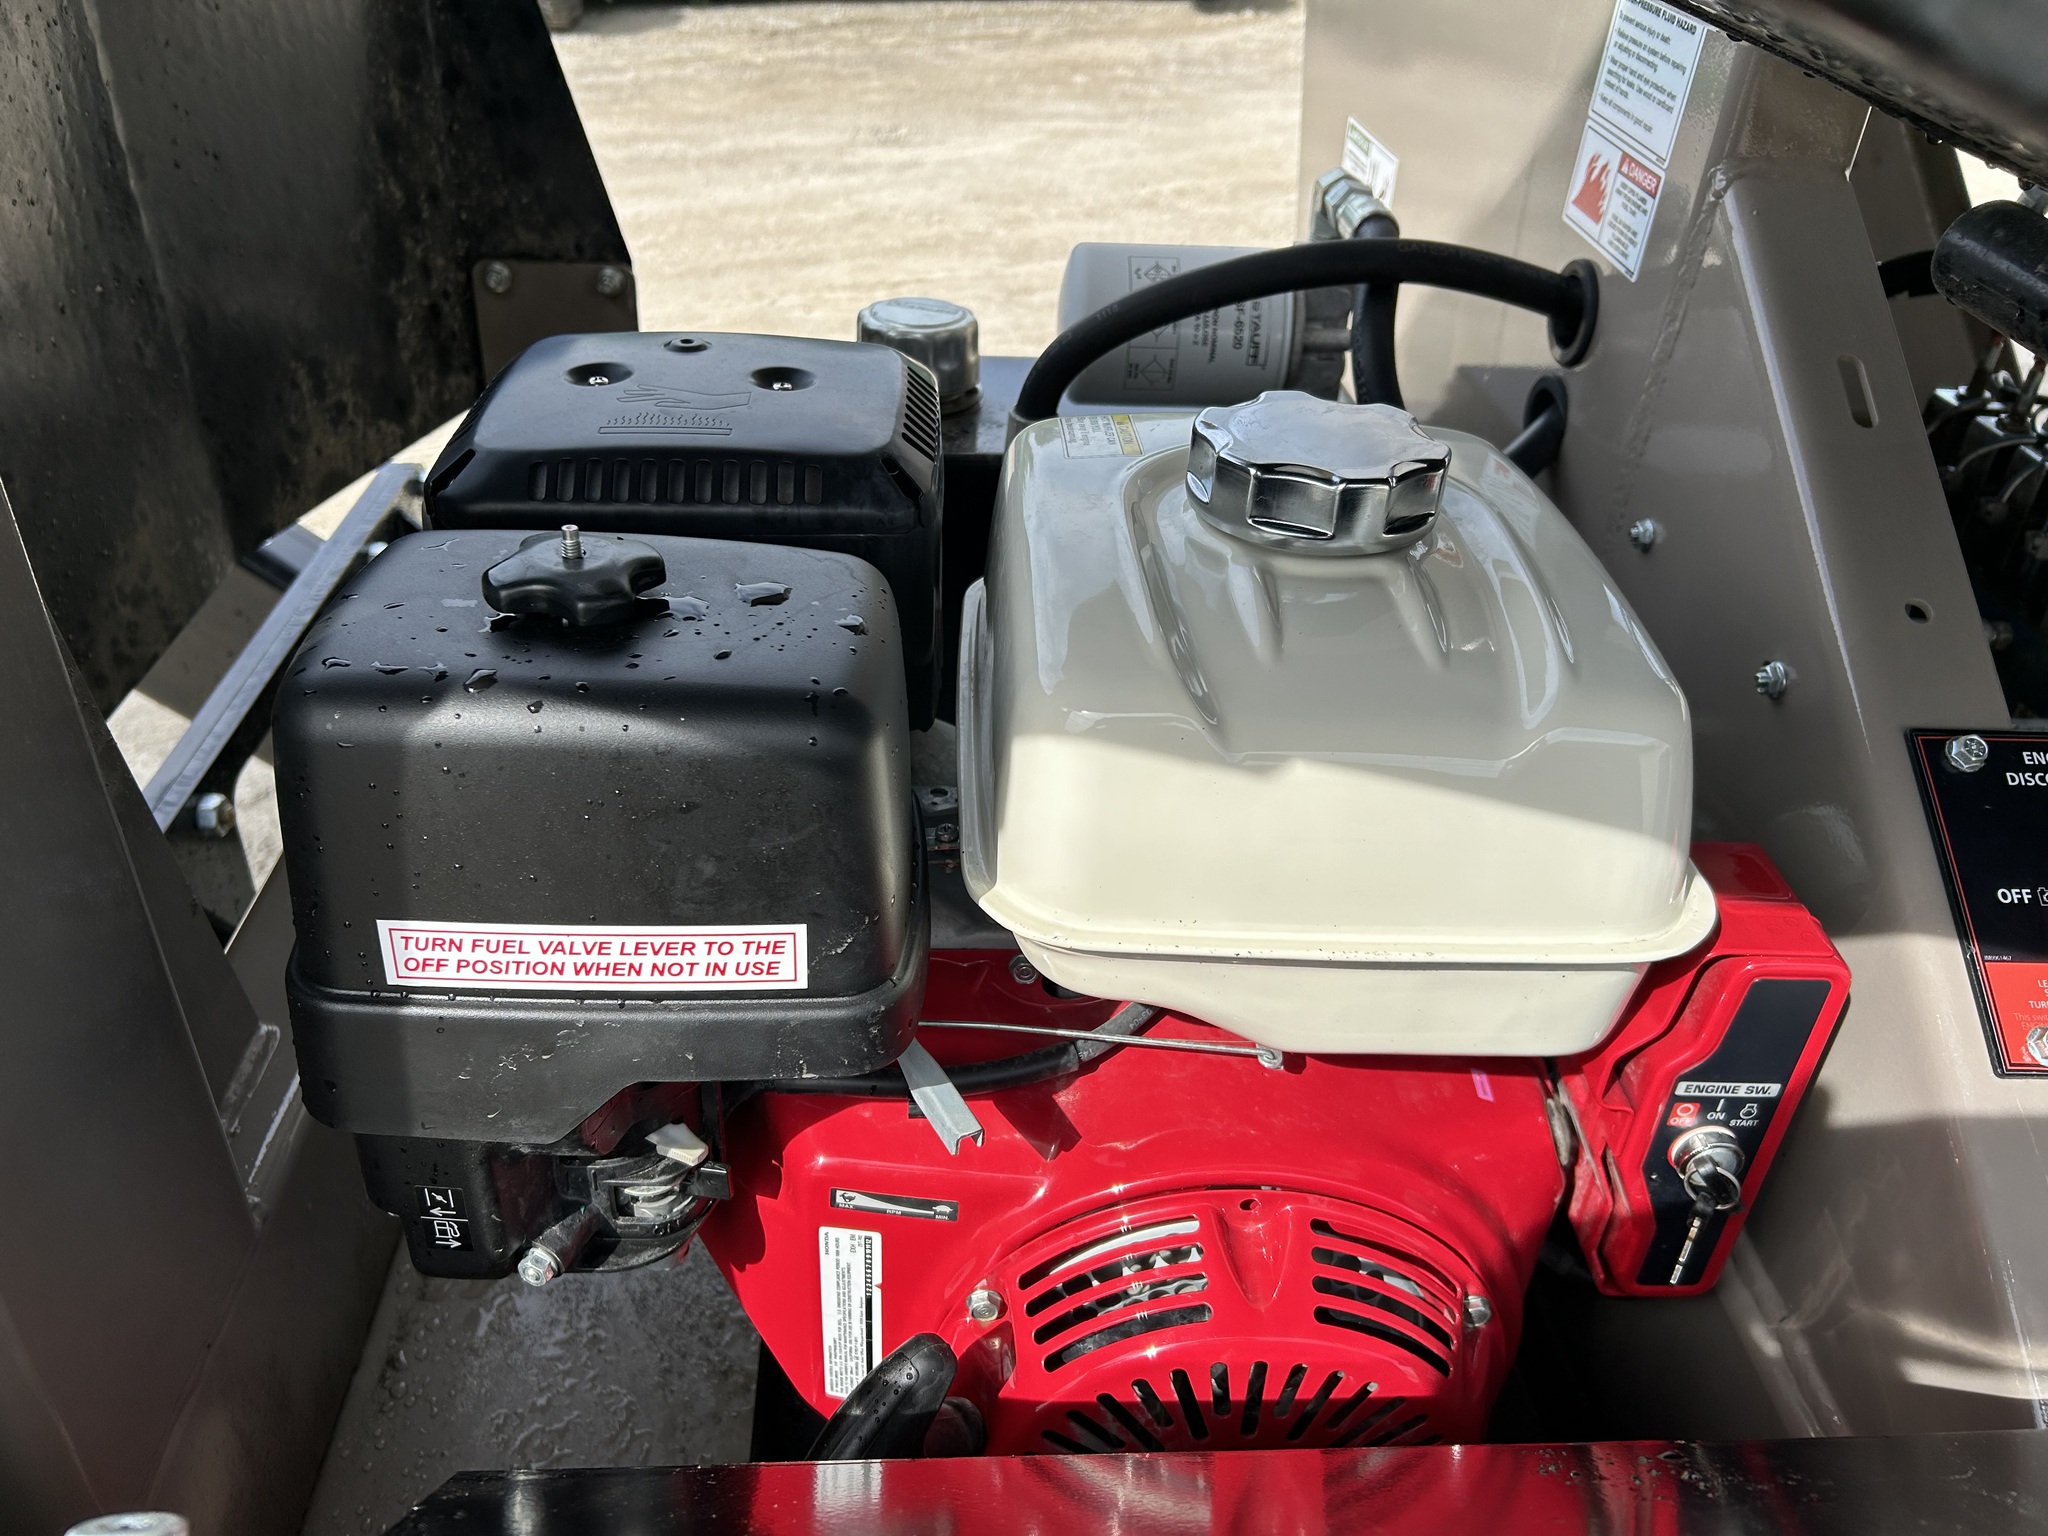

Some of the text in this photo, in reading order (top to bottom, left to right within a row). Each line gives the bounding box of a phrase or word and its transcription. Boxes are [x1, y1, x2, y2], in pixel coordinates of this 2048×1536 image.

[1661, 9, 1676, 24] FLUID
[1675, 18, 1696, 34] HAZARD
[1628, 164, 1658, 193] DANGER
[1118, 425, 1134, 444] CAUTION
[2022, 751, 2048, 765] EN
[2006, 772, 2048, 786] DISC
[1997, 888, 2032, 904] OFF
[400, 936, 786, 956] TURN FUEL VALVE LEVER TO THE
[404, 957, 781, 977] OFF POSITION WHEN NOT IN USE
[2013, 1012, 2030, 1021] This
[1684, 1084, 1771, 1095] ENGINE SW.
[1707, 1112, 1726, 1120] ON
[1729, 1119, 1759, 1127] START
